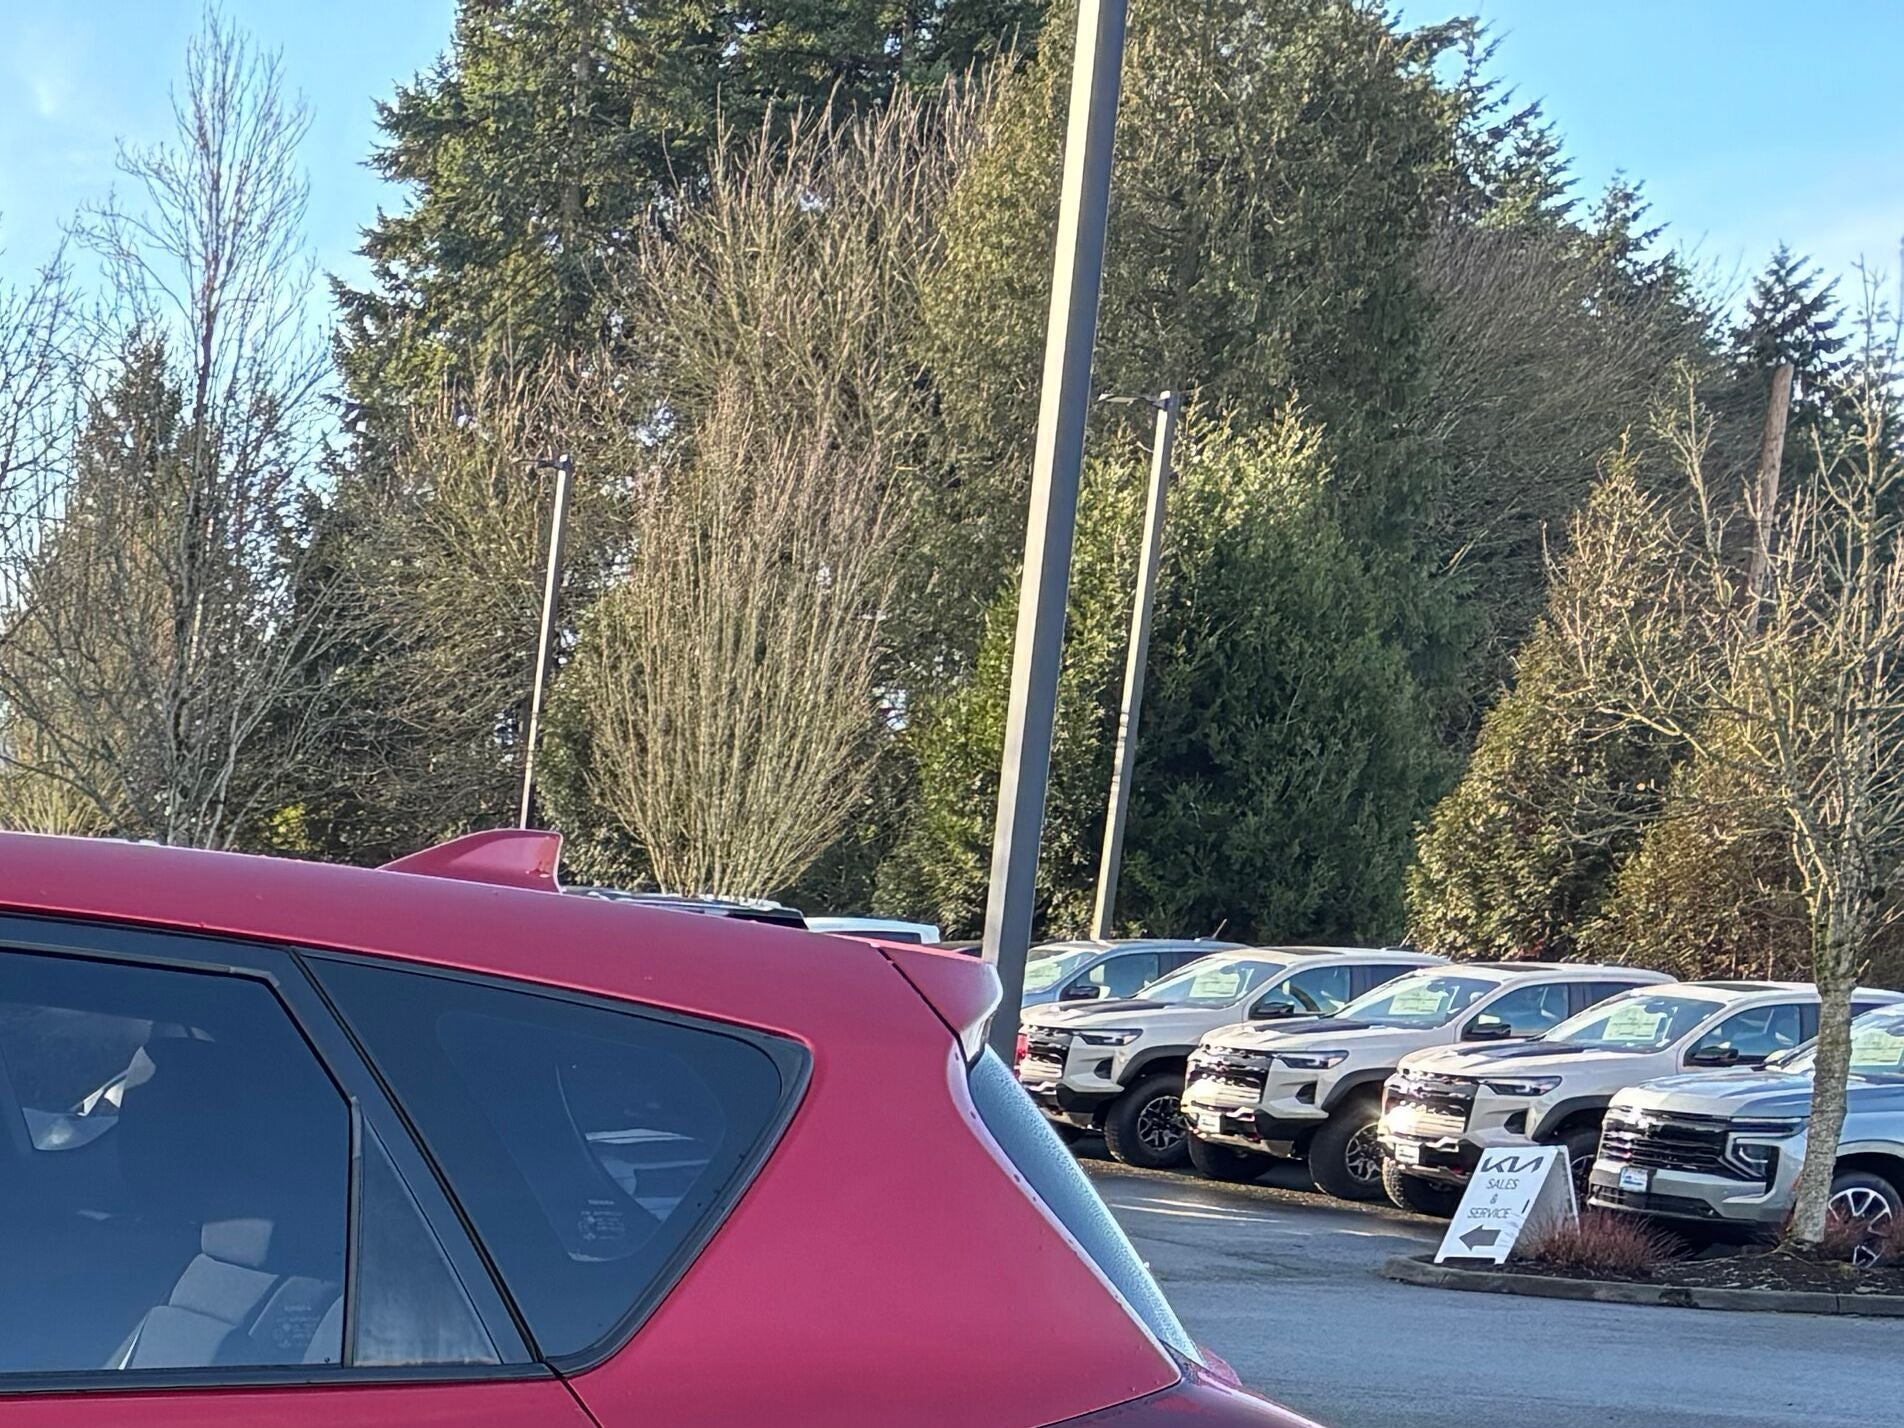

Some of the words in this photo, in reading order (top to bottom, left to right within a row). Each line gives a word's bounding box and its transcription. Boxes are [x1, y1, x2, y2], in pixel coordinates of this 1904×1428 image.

[1480, 1155, 1545, 1173] KIA
[1485, 1178, 1520, 1190] SALES
[1490, 1193, 1499, 1205] &
[1467, 1207, 1512, 1219] SERVICE
